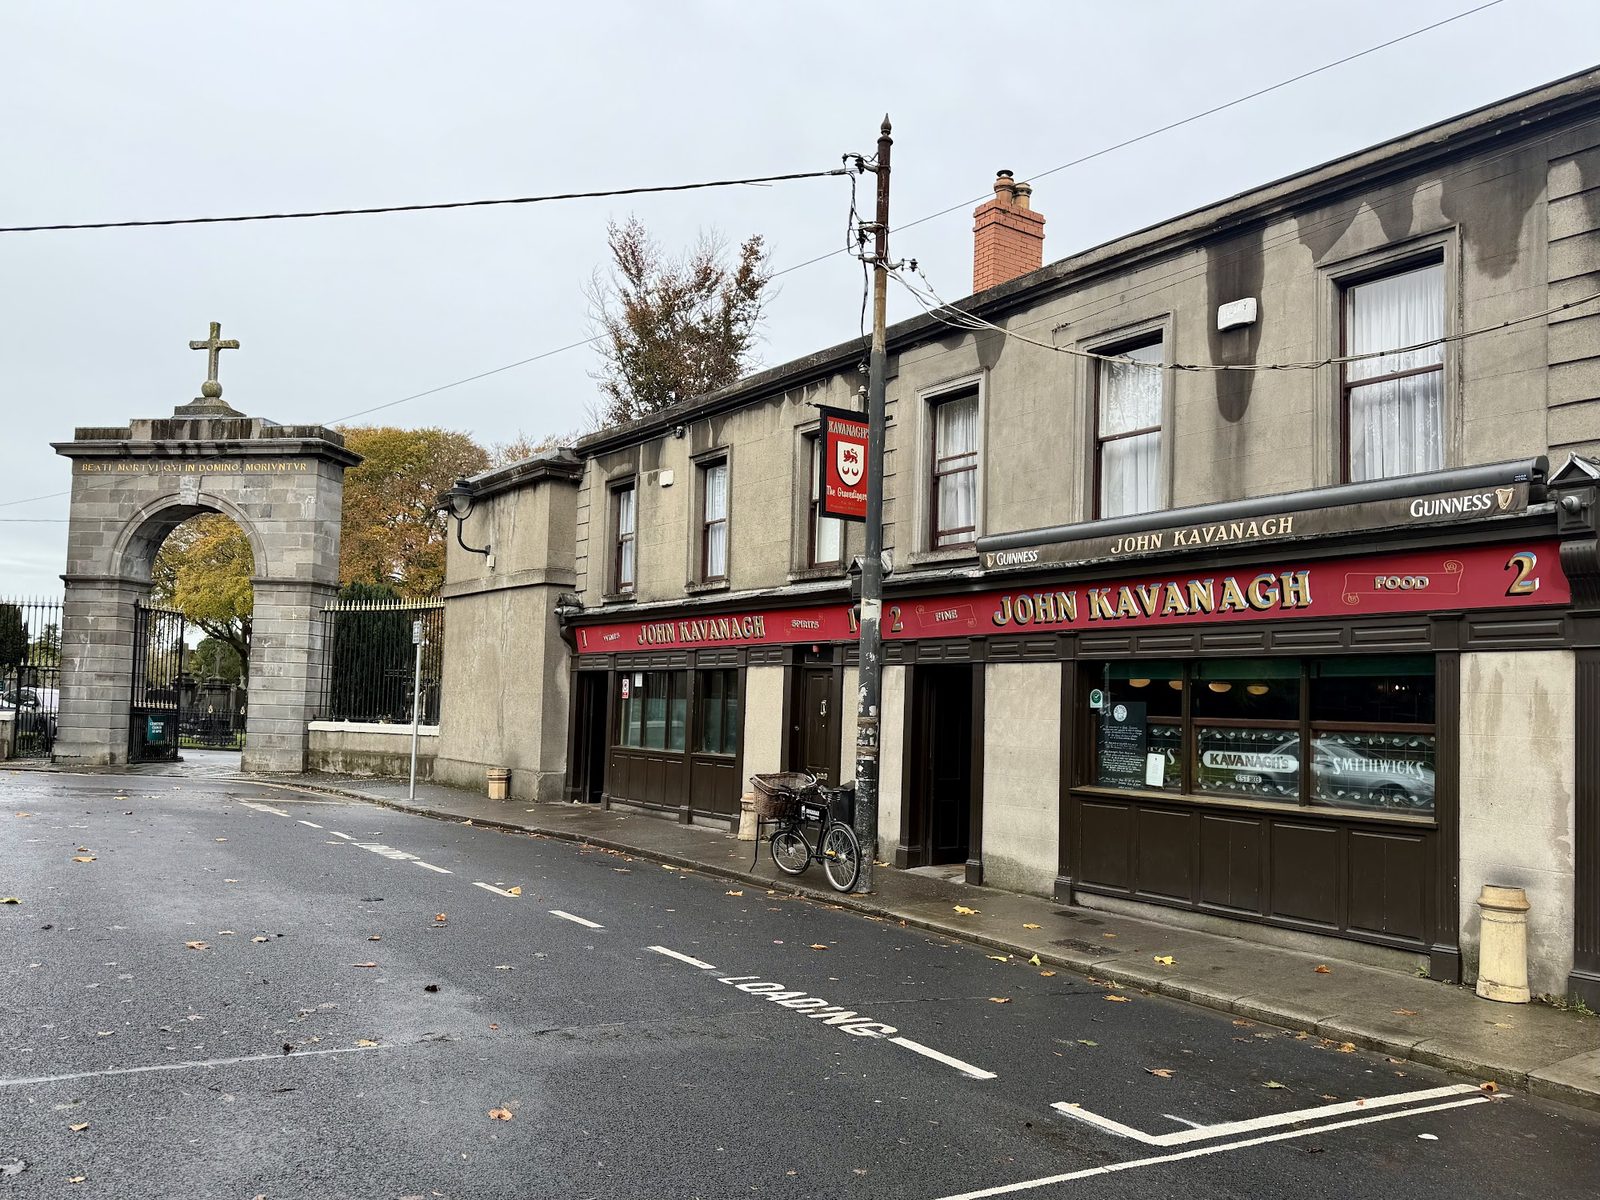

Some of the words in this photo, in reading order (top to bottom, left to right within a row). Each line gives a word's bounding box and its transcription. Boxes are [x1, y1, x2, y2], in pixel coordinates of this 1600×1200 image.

[82, 463, 112, 472] BEATI
[117, 463, 158, 472] MORTVI
[163, 463, 182, 472] QVI
[185, 463, 195, 472] IN
[199, 463, 239, 472] DOMINO
[245, 462, 307, 472] MORIVNTVR
[826, 485, 836, 496] The
[1410, 493, 1494, 517] GUINNESS
[1111, 532, 1163, 555] JOHN
[1173, 516, 1294, 546] KAVANAGH
[996, 549, 1039, 566] GUINNESS
[1373, 574, 1430, 592] FOOD
[1503, 551, 1540, 597] 2
[992, 590, 1078, 626] JOHN
[1087, 570, 1312, 621] KAVANAGH
[791, 619, 820, 629] SPIRITS
[888, 606, 904, 633] 2
[934, 609, 958, 622] FINE
[581, 629, 588, 648] 1
[637, 622, 676, 645] JOHN
[679, 615, 766, 642] KAVANAGH
[717, 976, 899, 1039] LOADING
